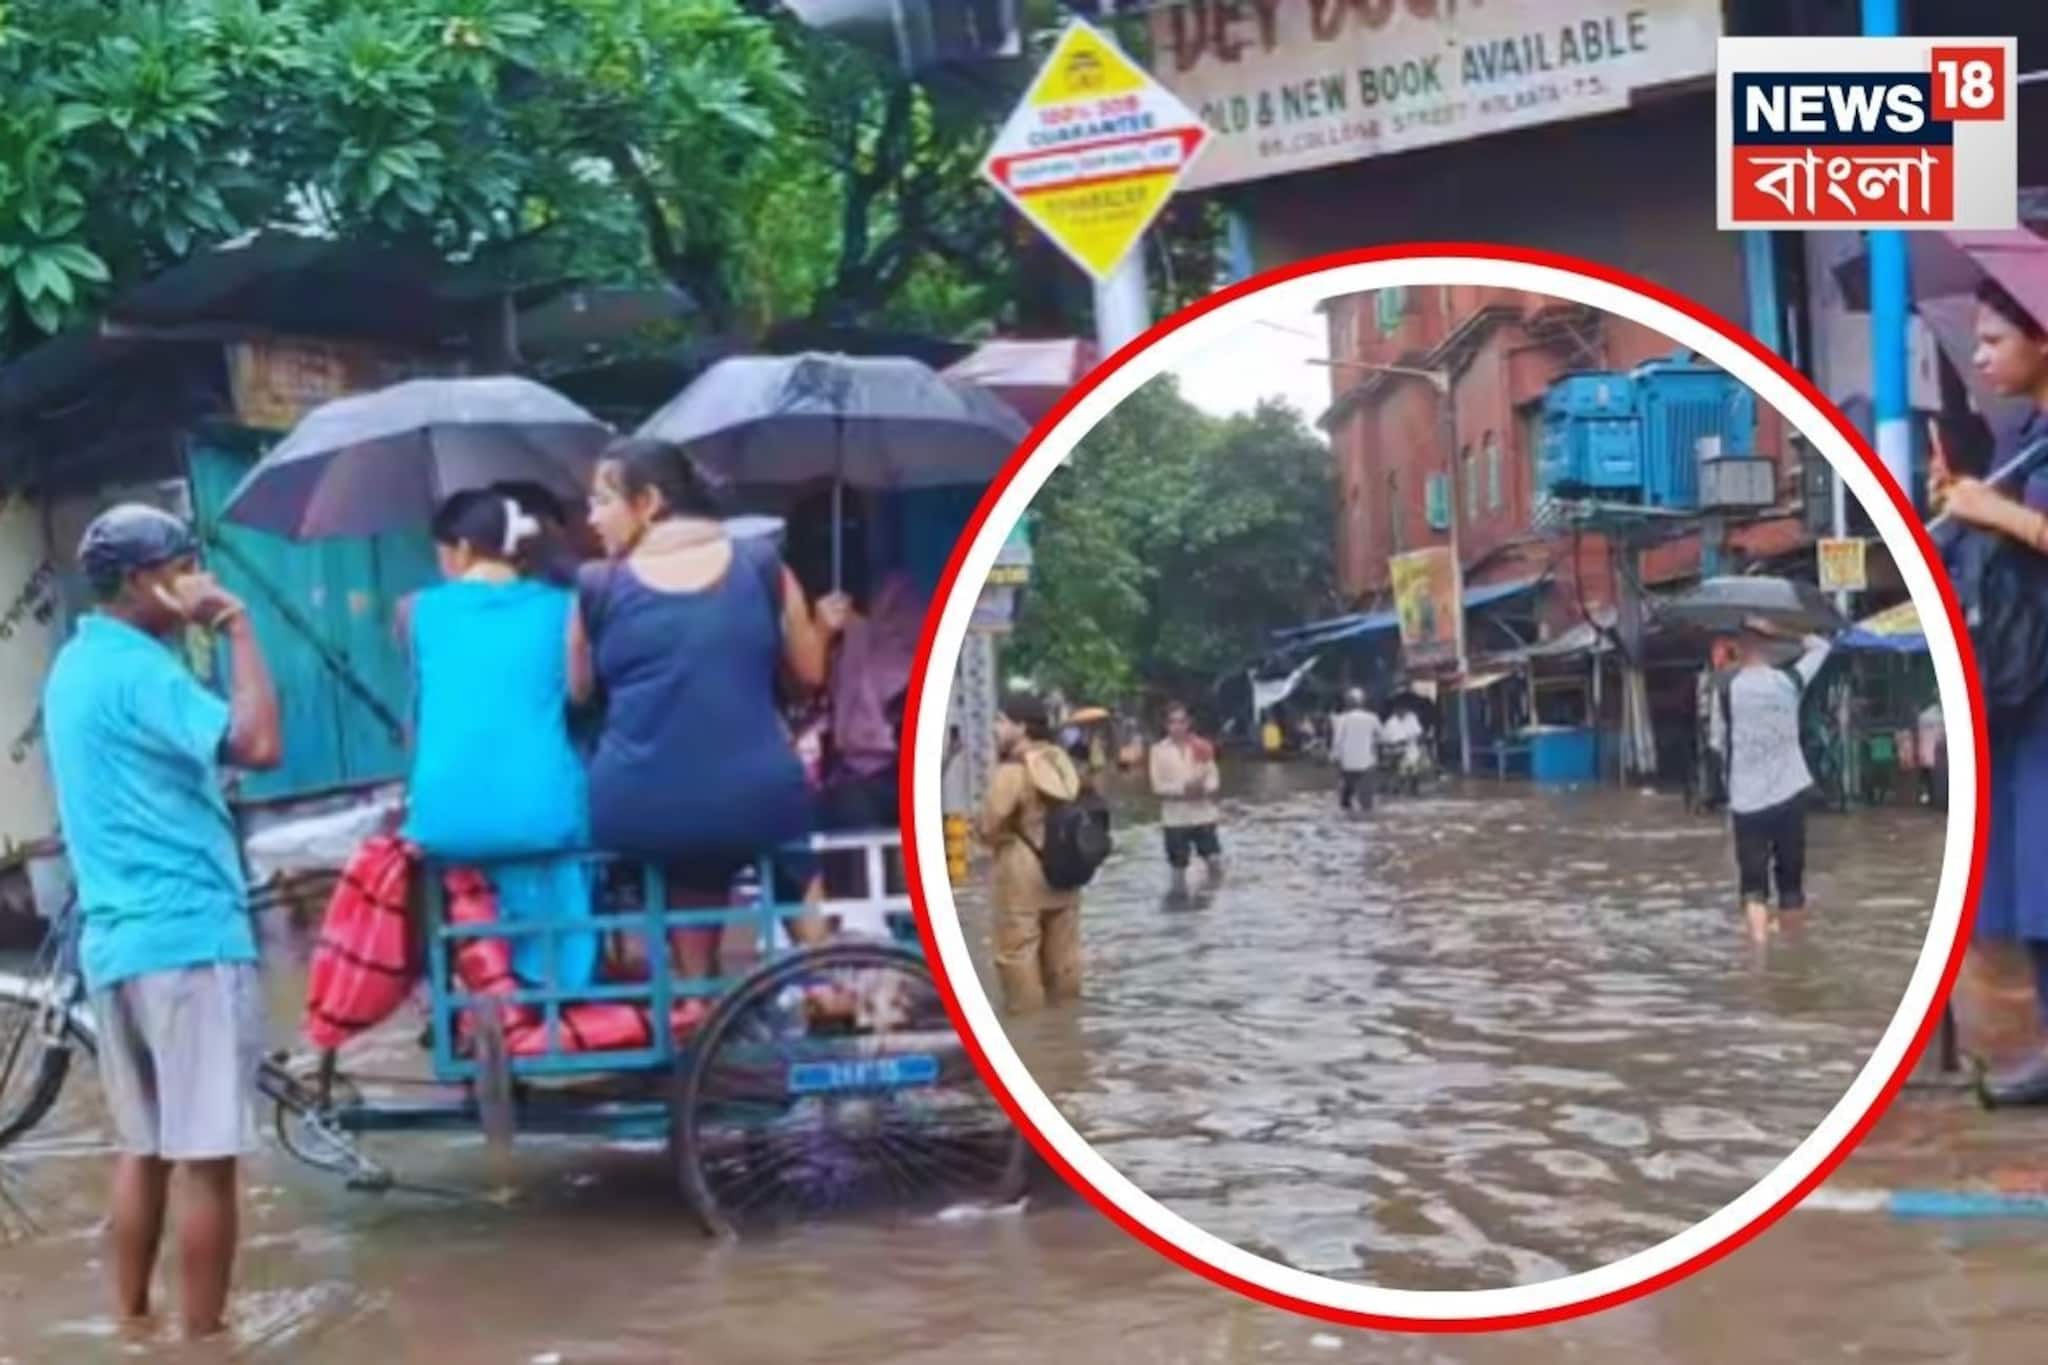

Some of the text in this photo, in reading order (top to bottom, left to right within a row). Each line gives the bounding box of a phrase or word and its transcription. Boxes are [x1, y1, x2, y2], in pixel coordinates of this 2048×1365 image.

[1202, 95, 1249, 135] OLD
[1256, 90, 1274, 126] &
[1281, 74, 1346, 123] NEW
[1357, 54, 1444, 107] BOOK
[1461, 11, 1649, 84] AVAILABLE
